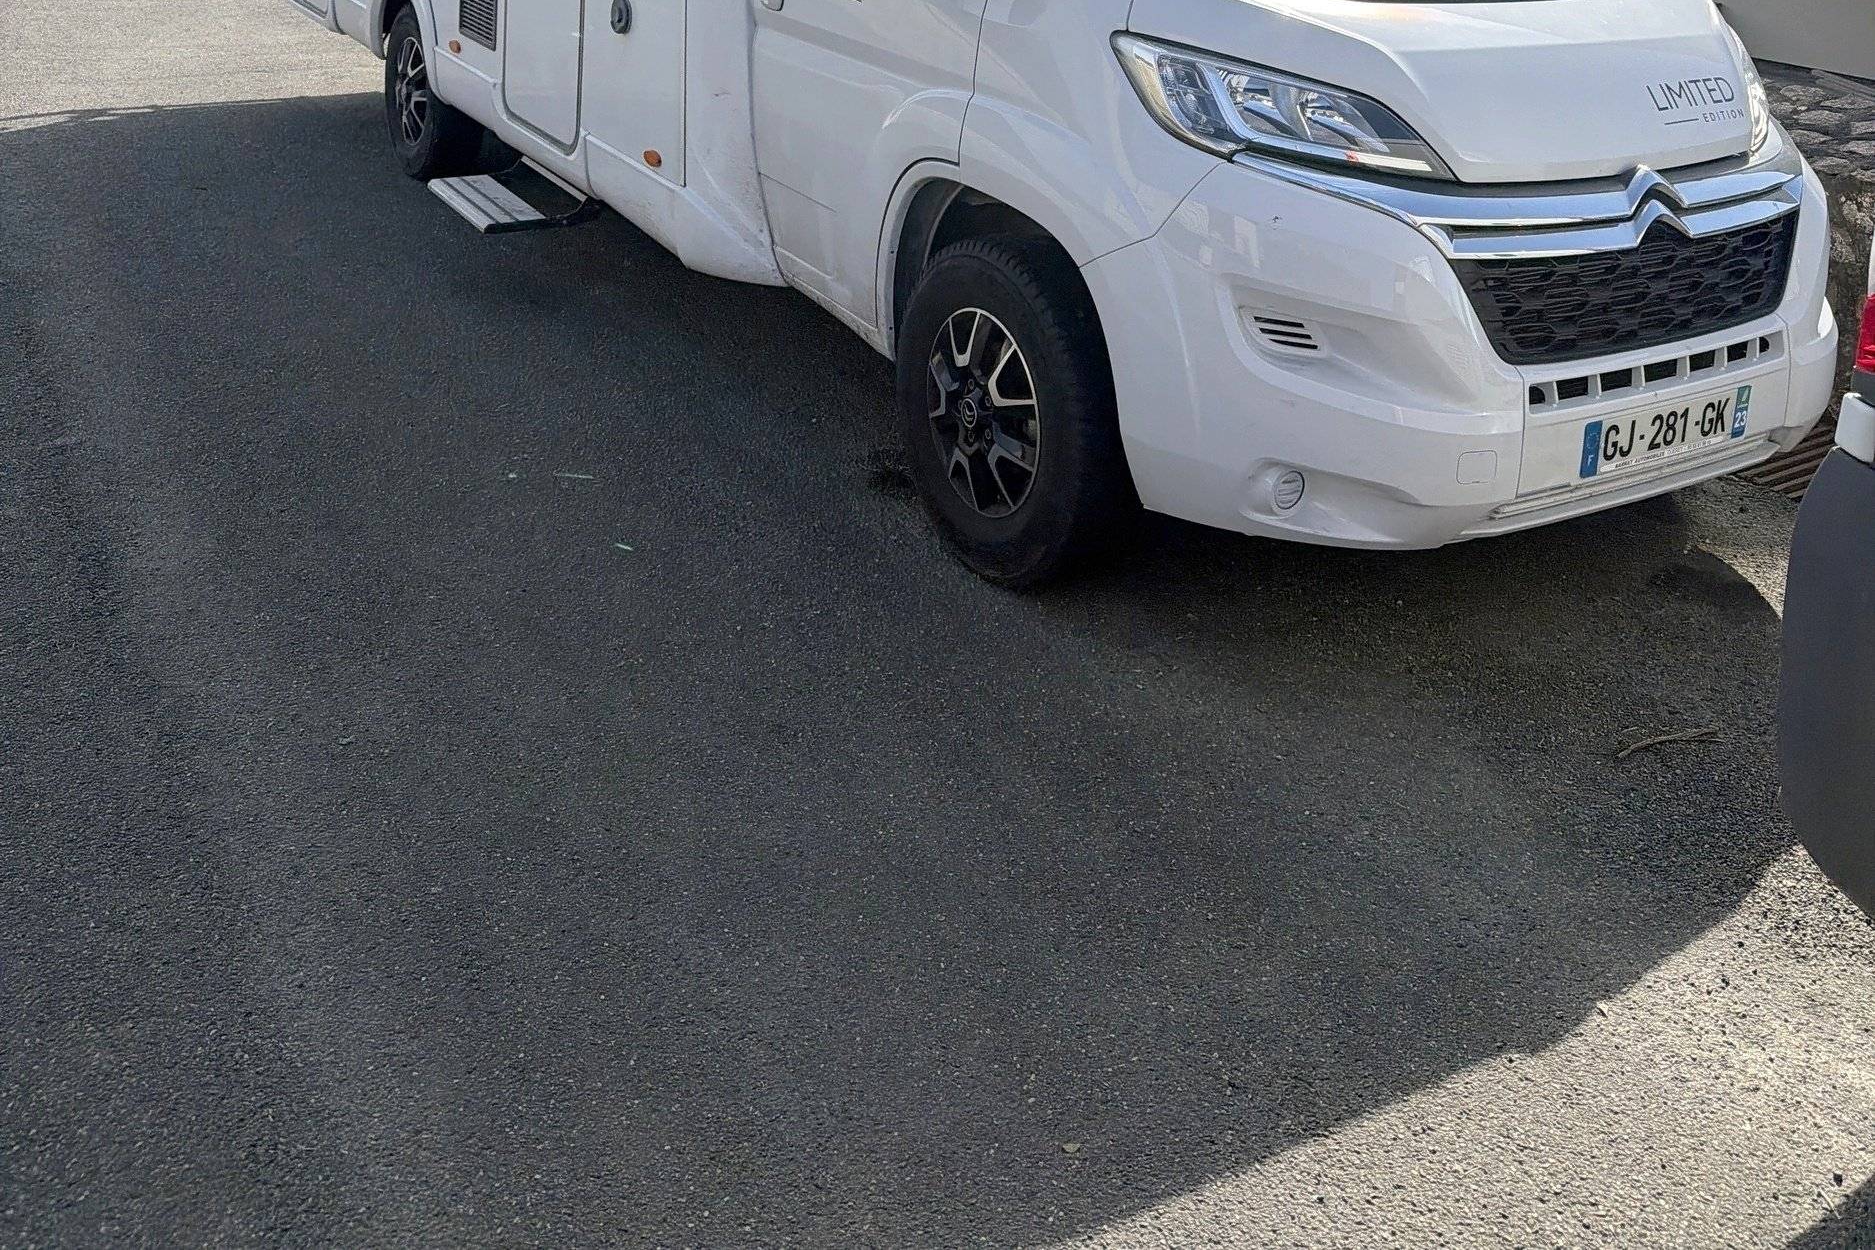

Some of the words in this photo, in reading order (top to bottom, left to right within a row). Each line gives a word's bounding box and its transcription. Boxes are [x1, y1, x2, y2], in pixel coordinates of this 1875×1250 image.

[1646, 77, 1735, 112] LIMITED
[1702, 108, 1744, 123] EDITION
[1734, 410, 1747, 428] 23
[1587, 454, 1594, 467] F
